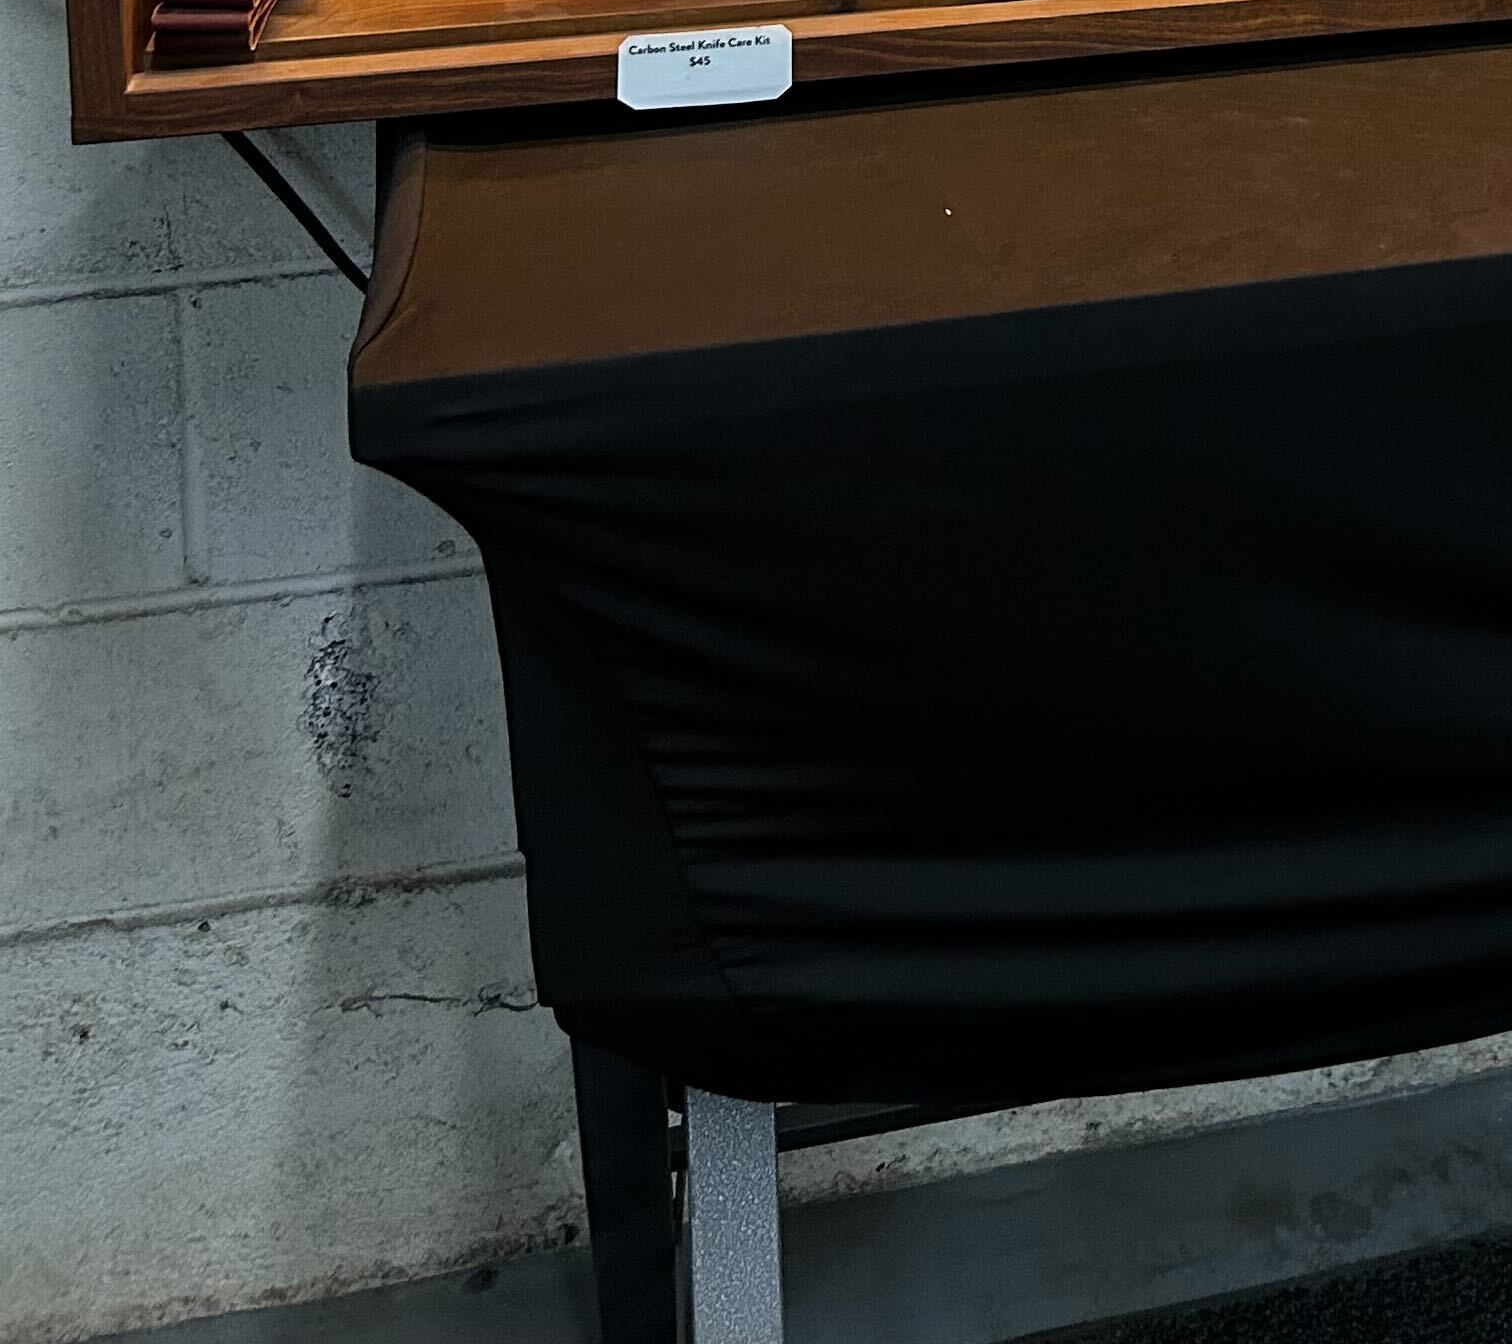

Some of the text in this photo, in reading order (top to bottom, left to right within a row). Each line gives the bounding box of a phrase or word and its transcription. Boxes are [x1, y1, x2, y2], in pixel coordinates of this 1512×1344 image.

[628, 35, 770, 55] Carbon Steel Knife Care Kit
[690, 56, 711, 67] $45
